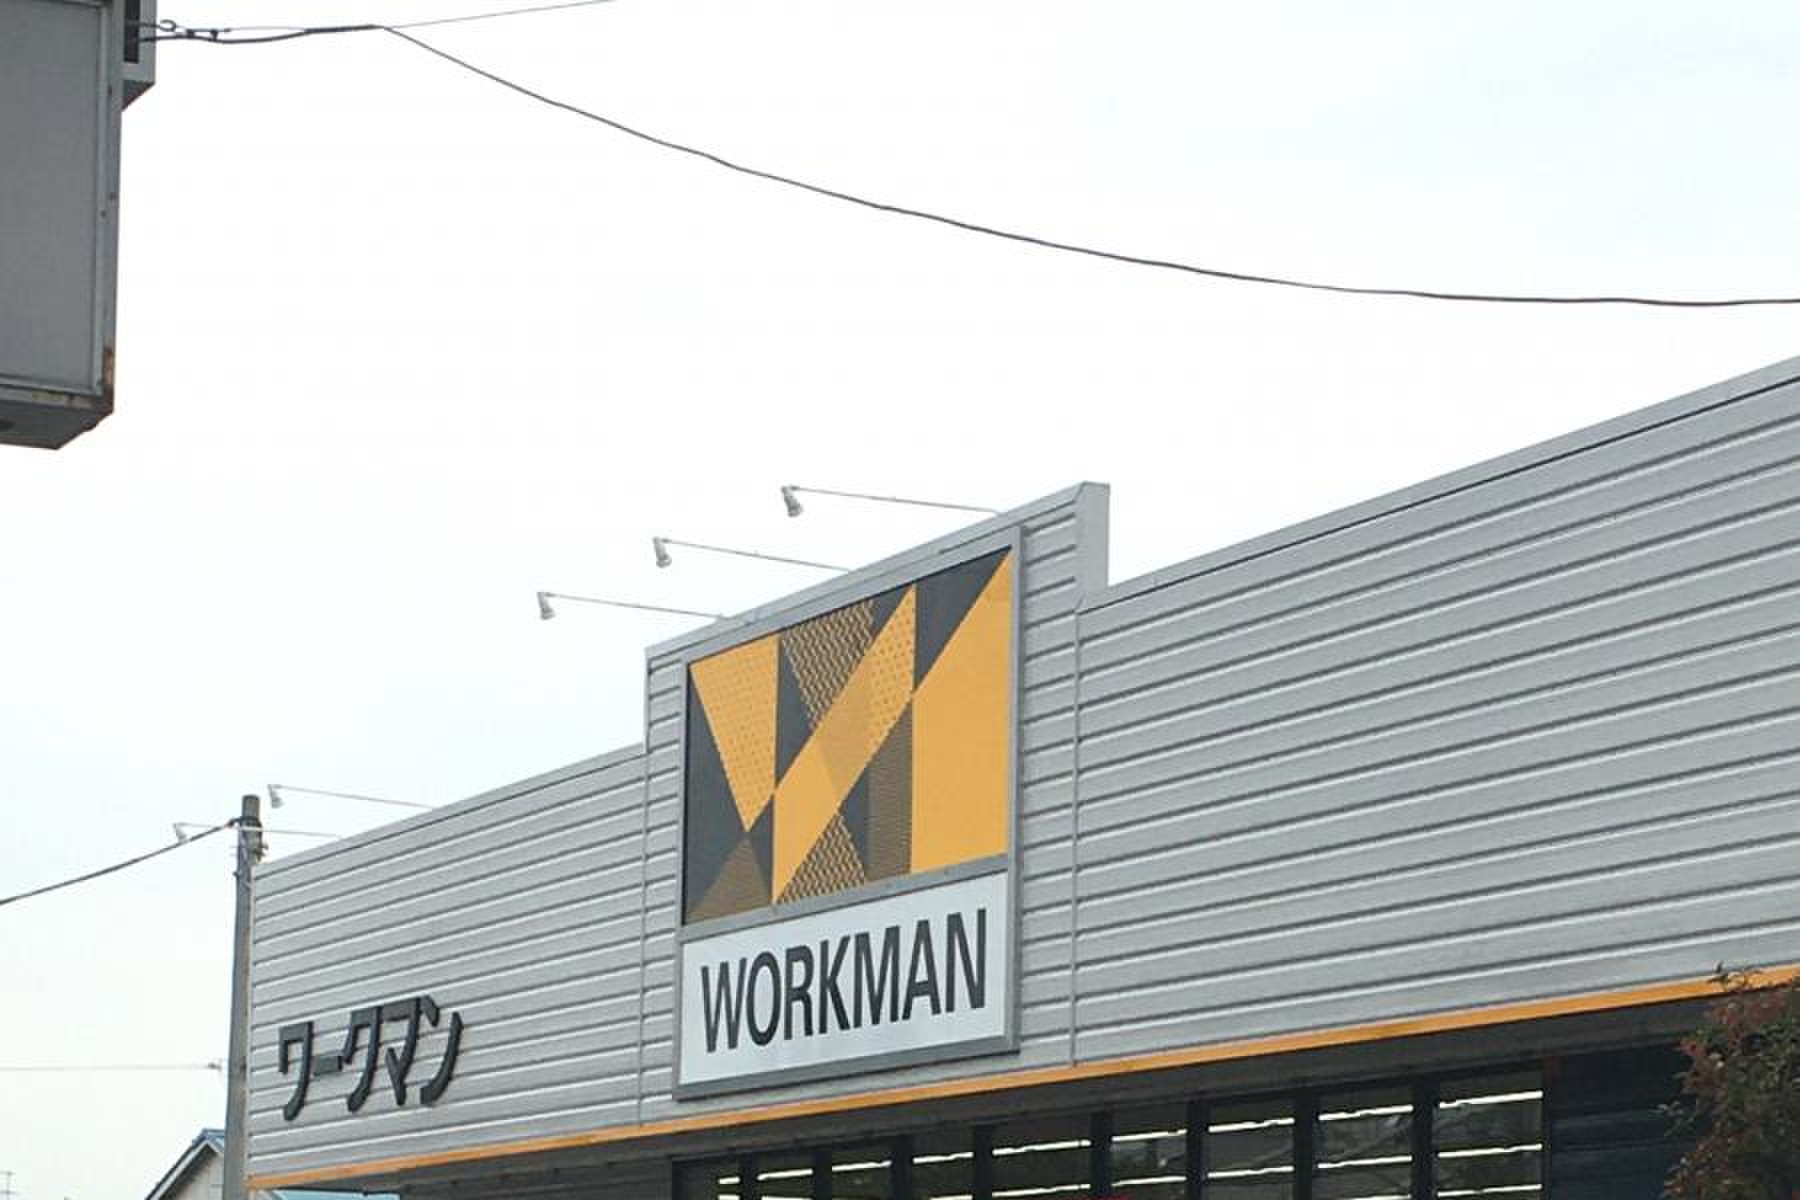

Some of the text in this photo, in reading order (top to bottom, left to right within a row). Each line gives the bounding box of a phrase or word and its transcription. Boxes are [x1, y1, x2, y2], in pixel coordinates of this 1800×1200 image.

[701, 908, 987, 1053] WORKMAN
[278, 995, 463, 1122] ワークマン
